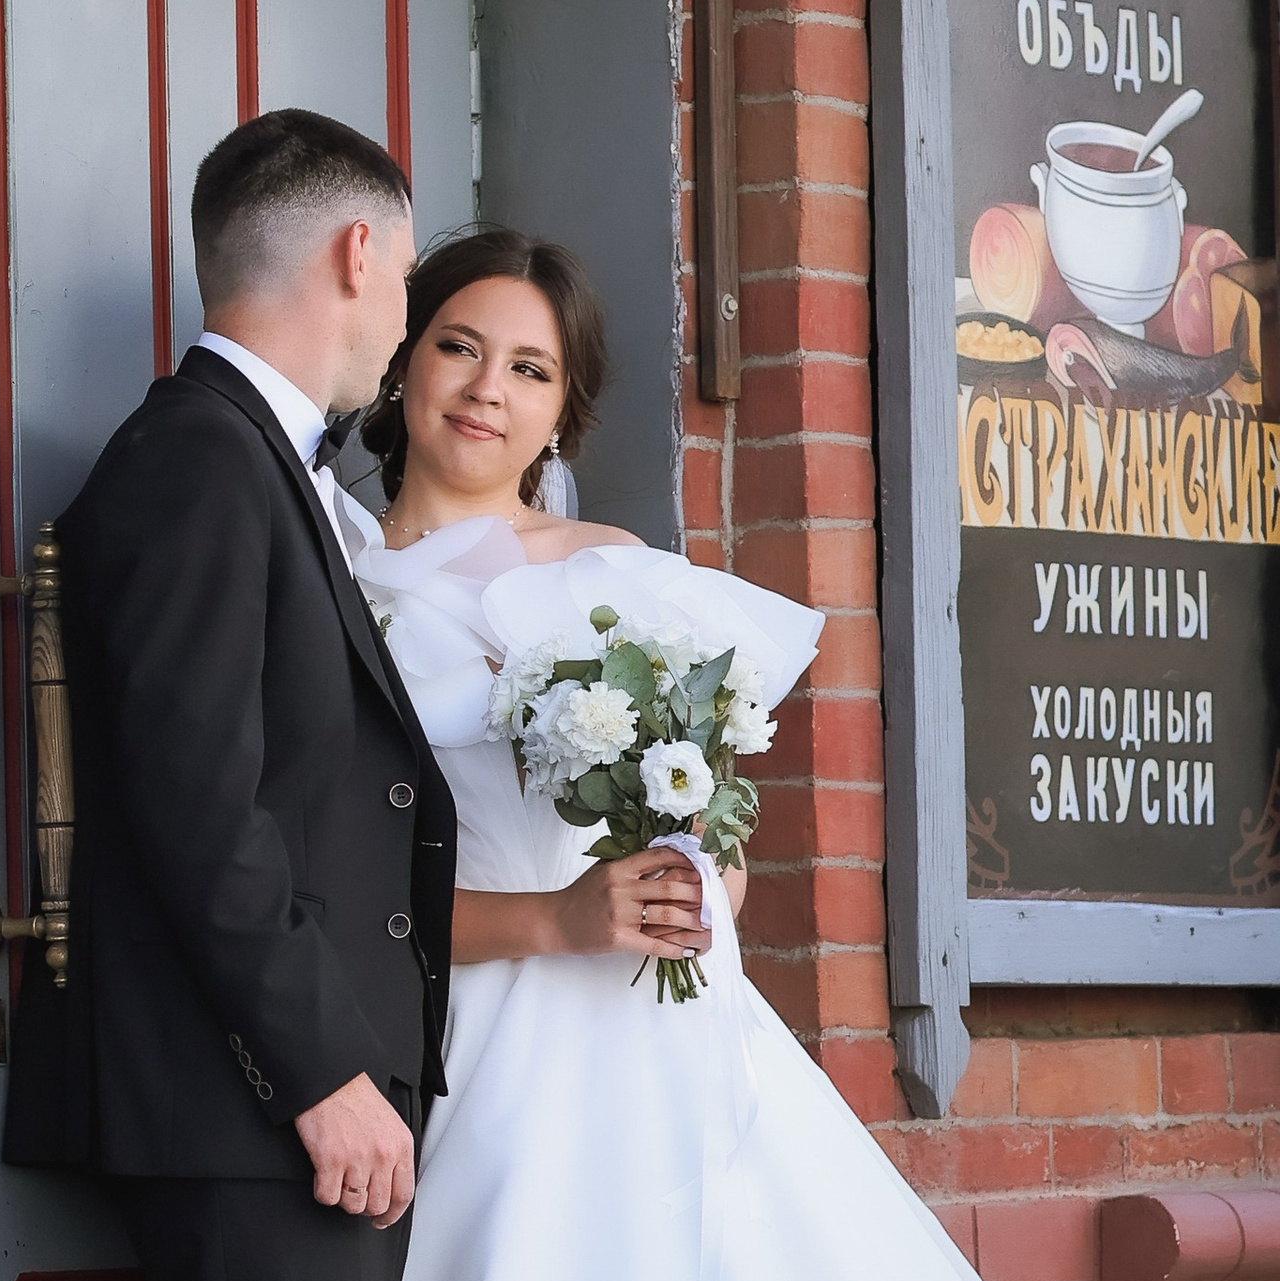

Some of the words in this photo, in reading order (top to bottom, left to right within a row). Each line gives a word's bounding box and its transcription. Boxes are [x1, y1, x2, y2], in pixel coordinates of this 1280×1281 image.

[958, 382, 1280, 545] СТРАХАНСКИЕ
[1033, 561, 1209, 640] УЖИНЫ
[1030, 684, 1214, 751] ХОЛОДНЫЯ
[1029, 753, 1216, 826] ЗАКУСКИ
